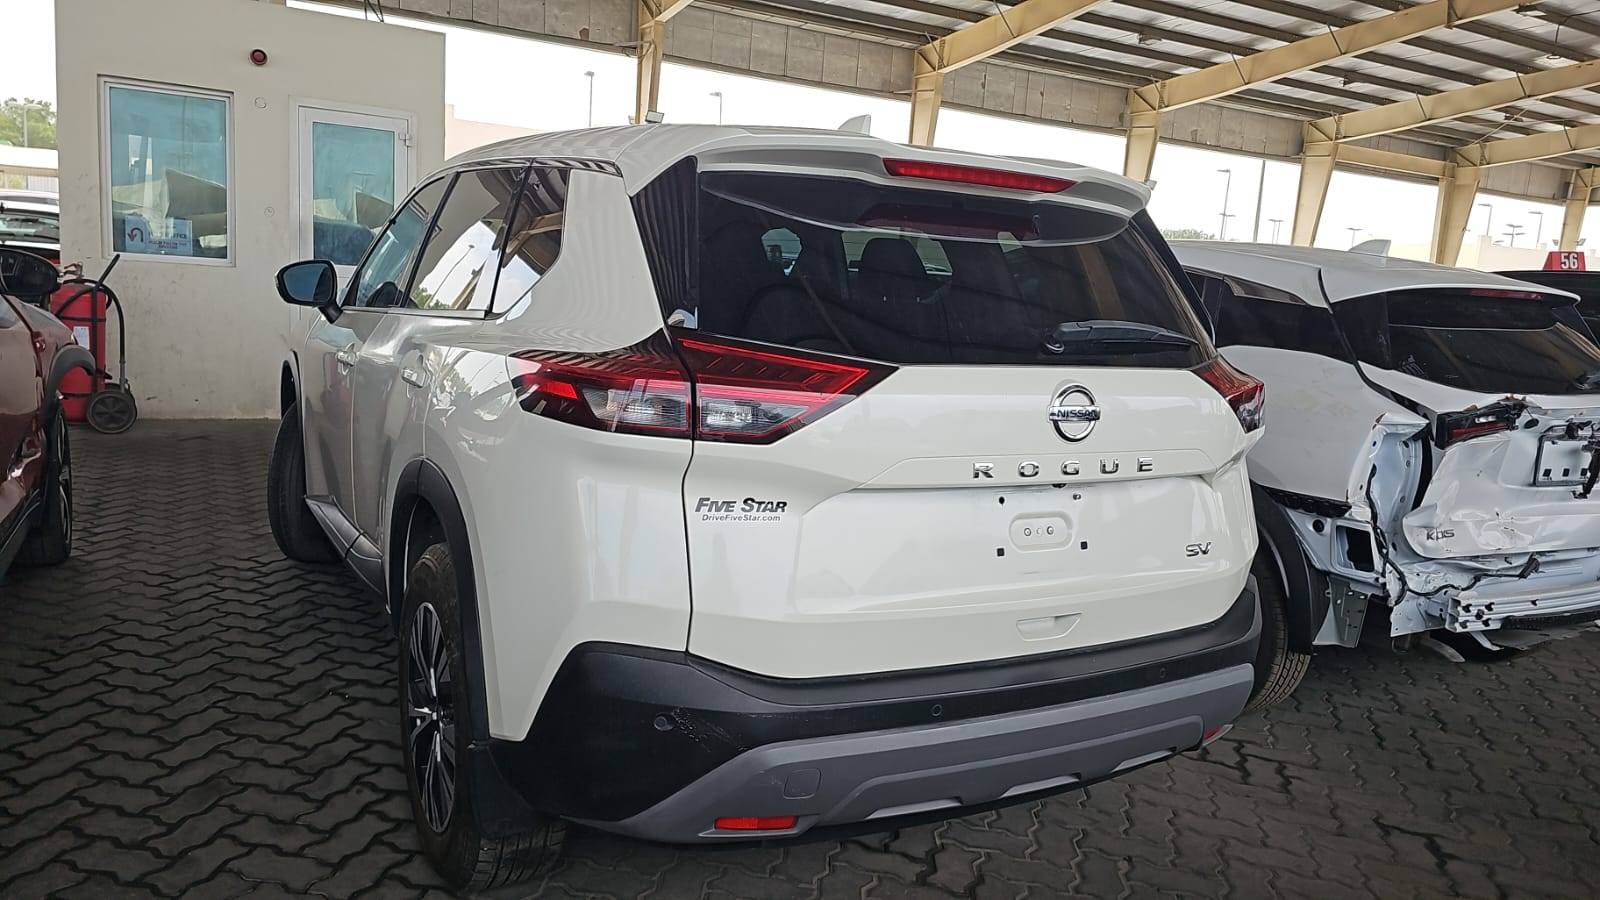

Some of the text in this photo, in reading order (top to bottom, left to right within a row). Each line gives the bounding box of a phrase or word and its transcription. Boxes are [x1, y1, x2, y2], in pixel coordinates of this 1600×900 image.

[1561, 252, 1578, 269] 56
[1056, 408, 1100, 420] NISSAN
[972, 456, 1154, 479] ROGUE
[701, 513, 781, 522] DriveFiveStar.com
[1185, 541, 1212, 558] SV
